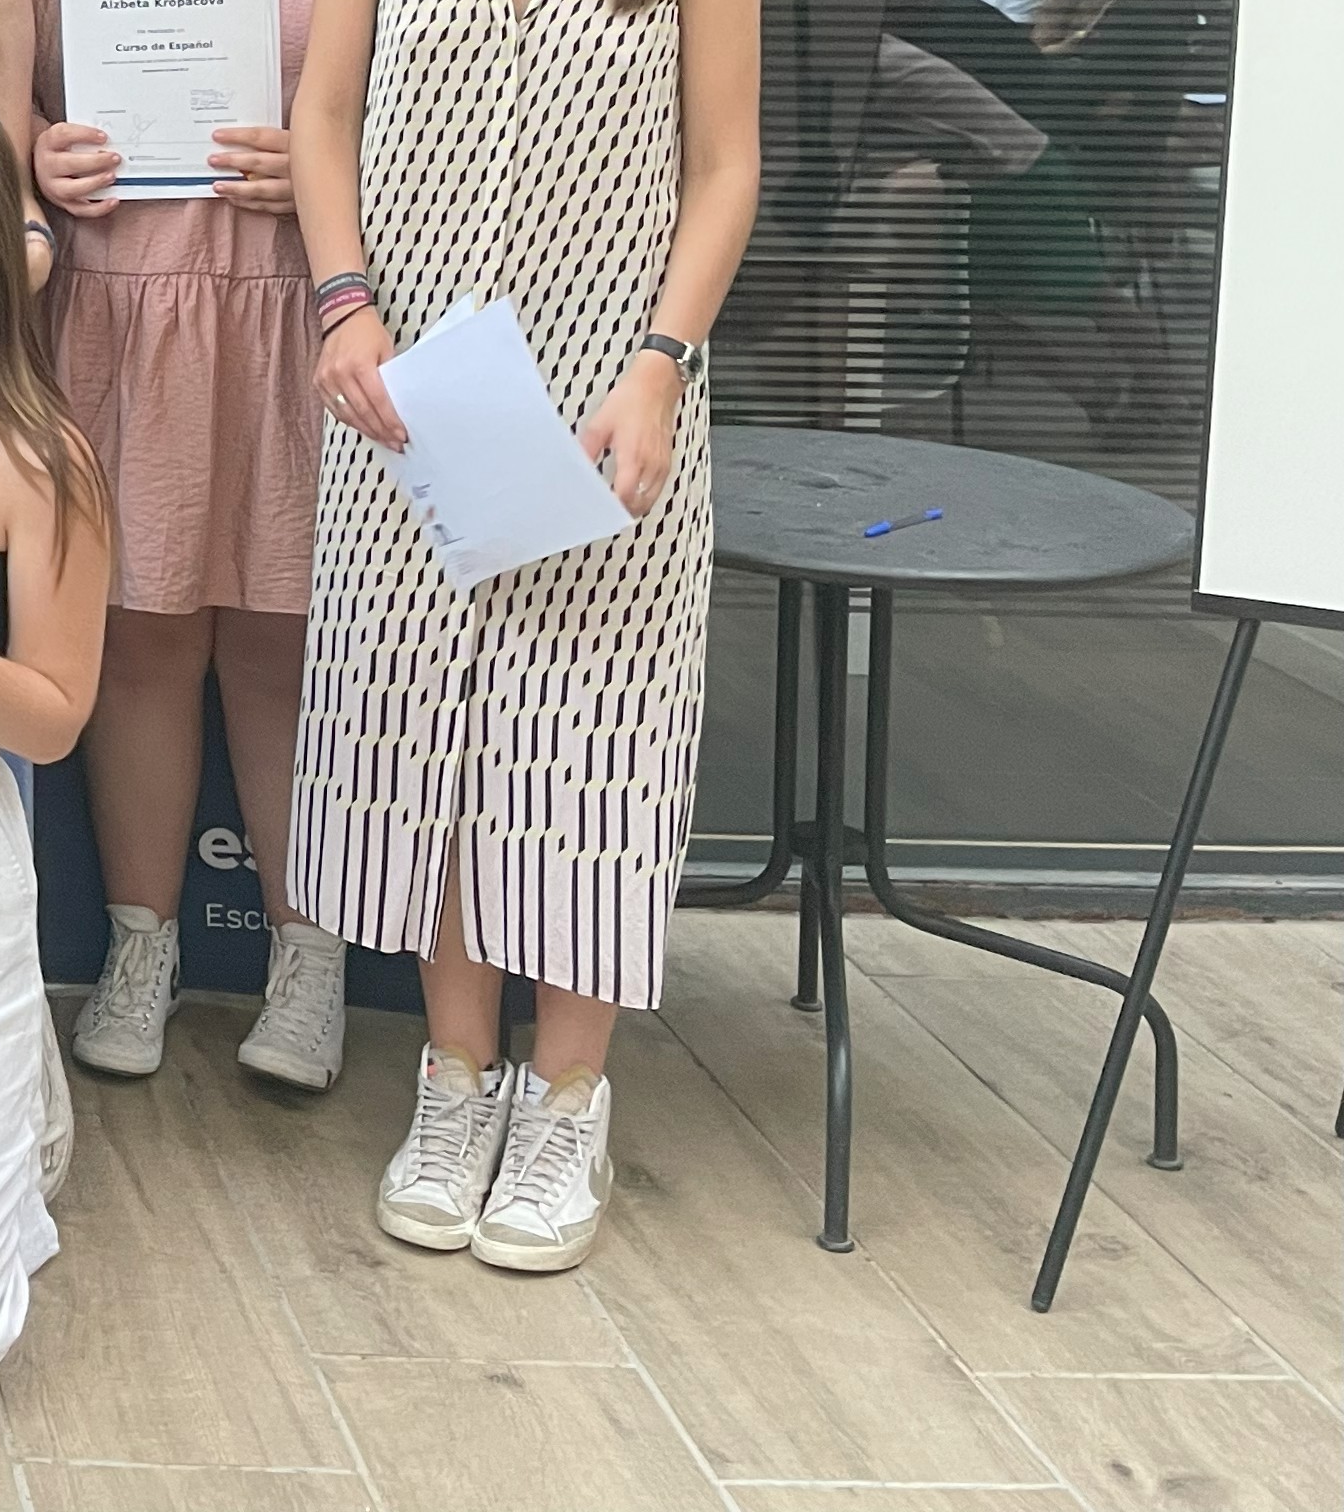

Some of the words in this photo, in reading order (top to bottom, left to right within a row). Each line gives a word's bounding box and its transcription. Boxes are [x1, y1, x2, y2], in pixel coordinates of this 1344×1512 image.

[115, 43, 149, 53] Curso
[151, 42, 166, 51] de
[168, 40, 214, 52] Español
